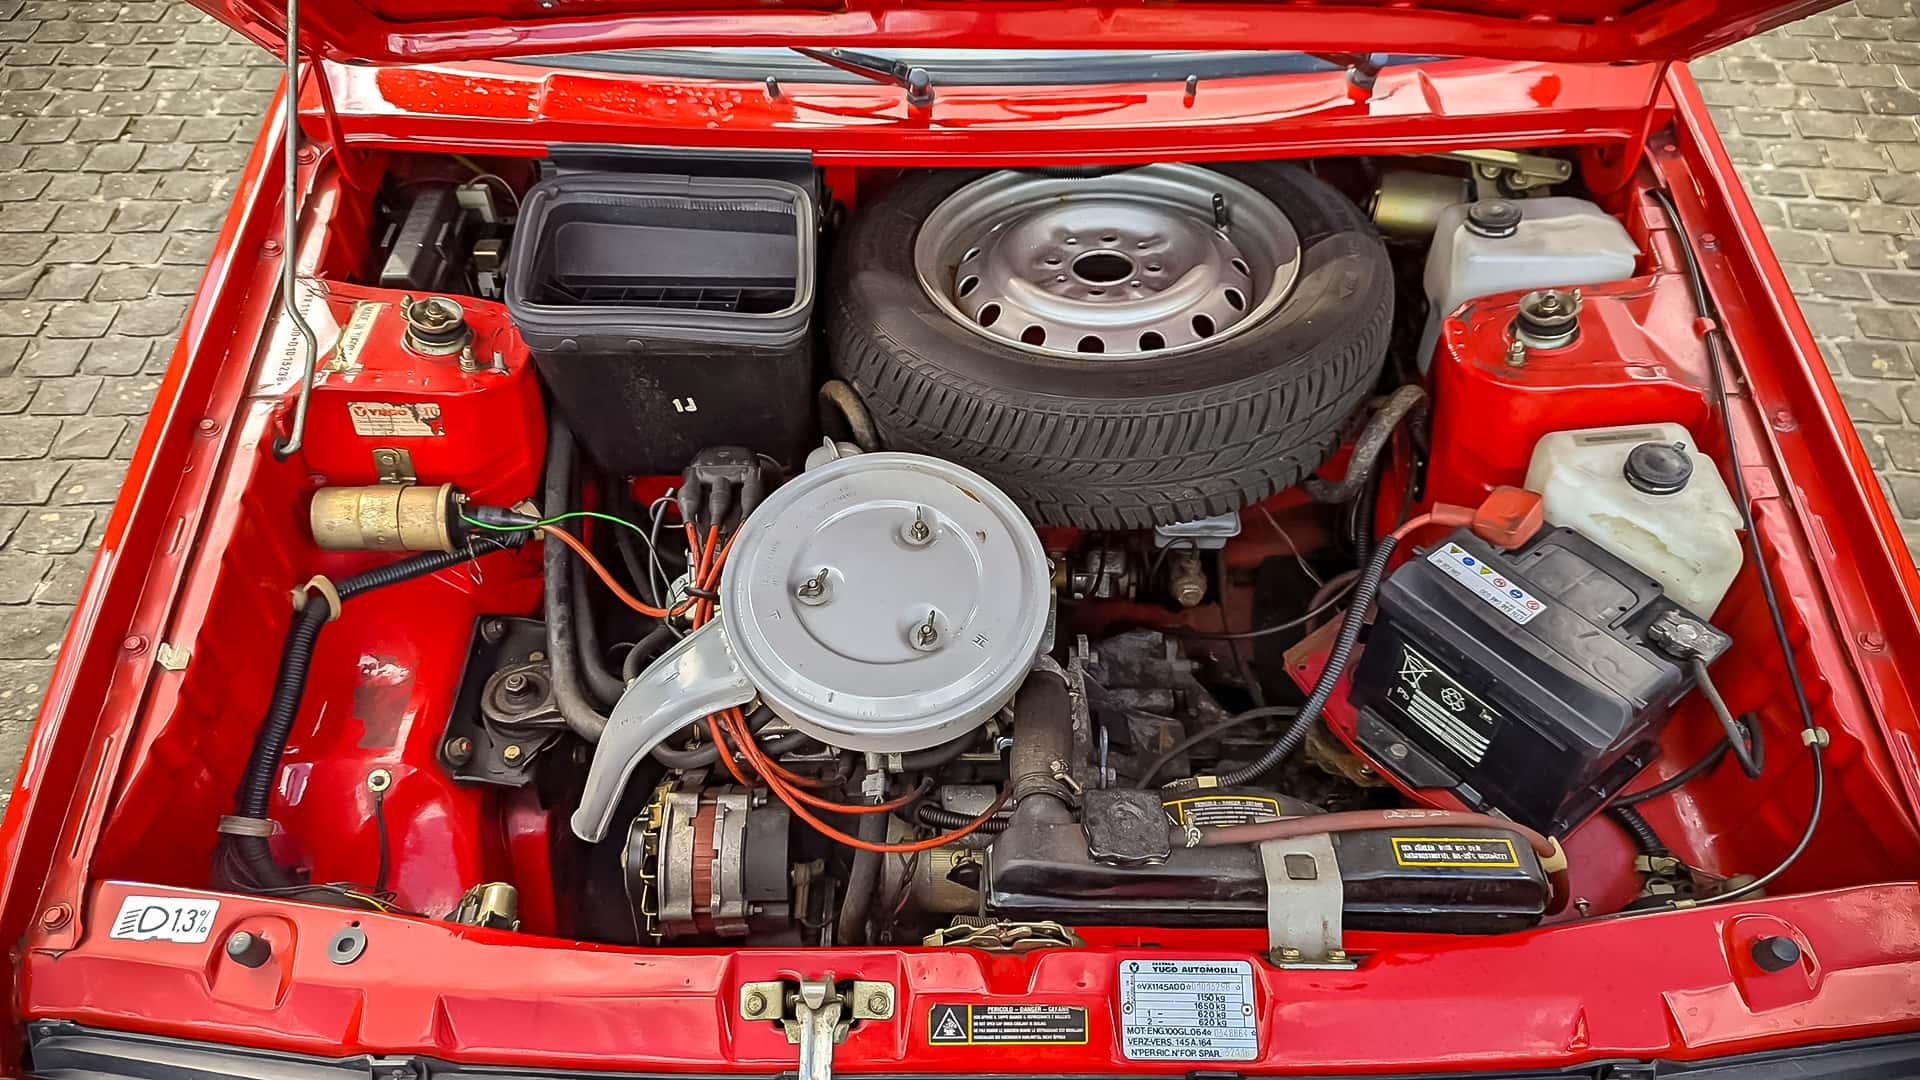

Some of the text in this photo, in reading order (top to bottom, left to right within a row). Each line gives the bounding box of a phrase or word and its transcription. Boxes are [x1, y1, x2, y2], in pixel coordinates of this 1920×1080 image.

[1181, 966, 1238, 974] AUTOMOBILI
[1215, 993, 1226, 1003] kg
[1194, 1001, 1226, 1011] 1650 kg
[1216, 1010, 1226, 1019] kg
[1216, 1018, 1227, 1027] kg
